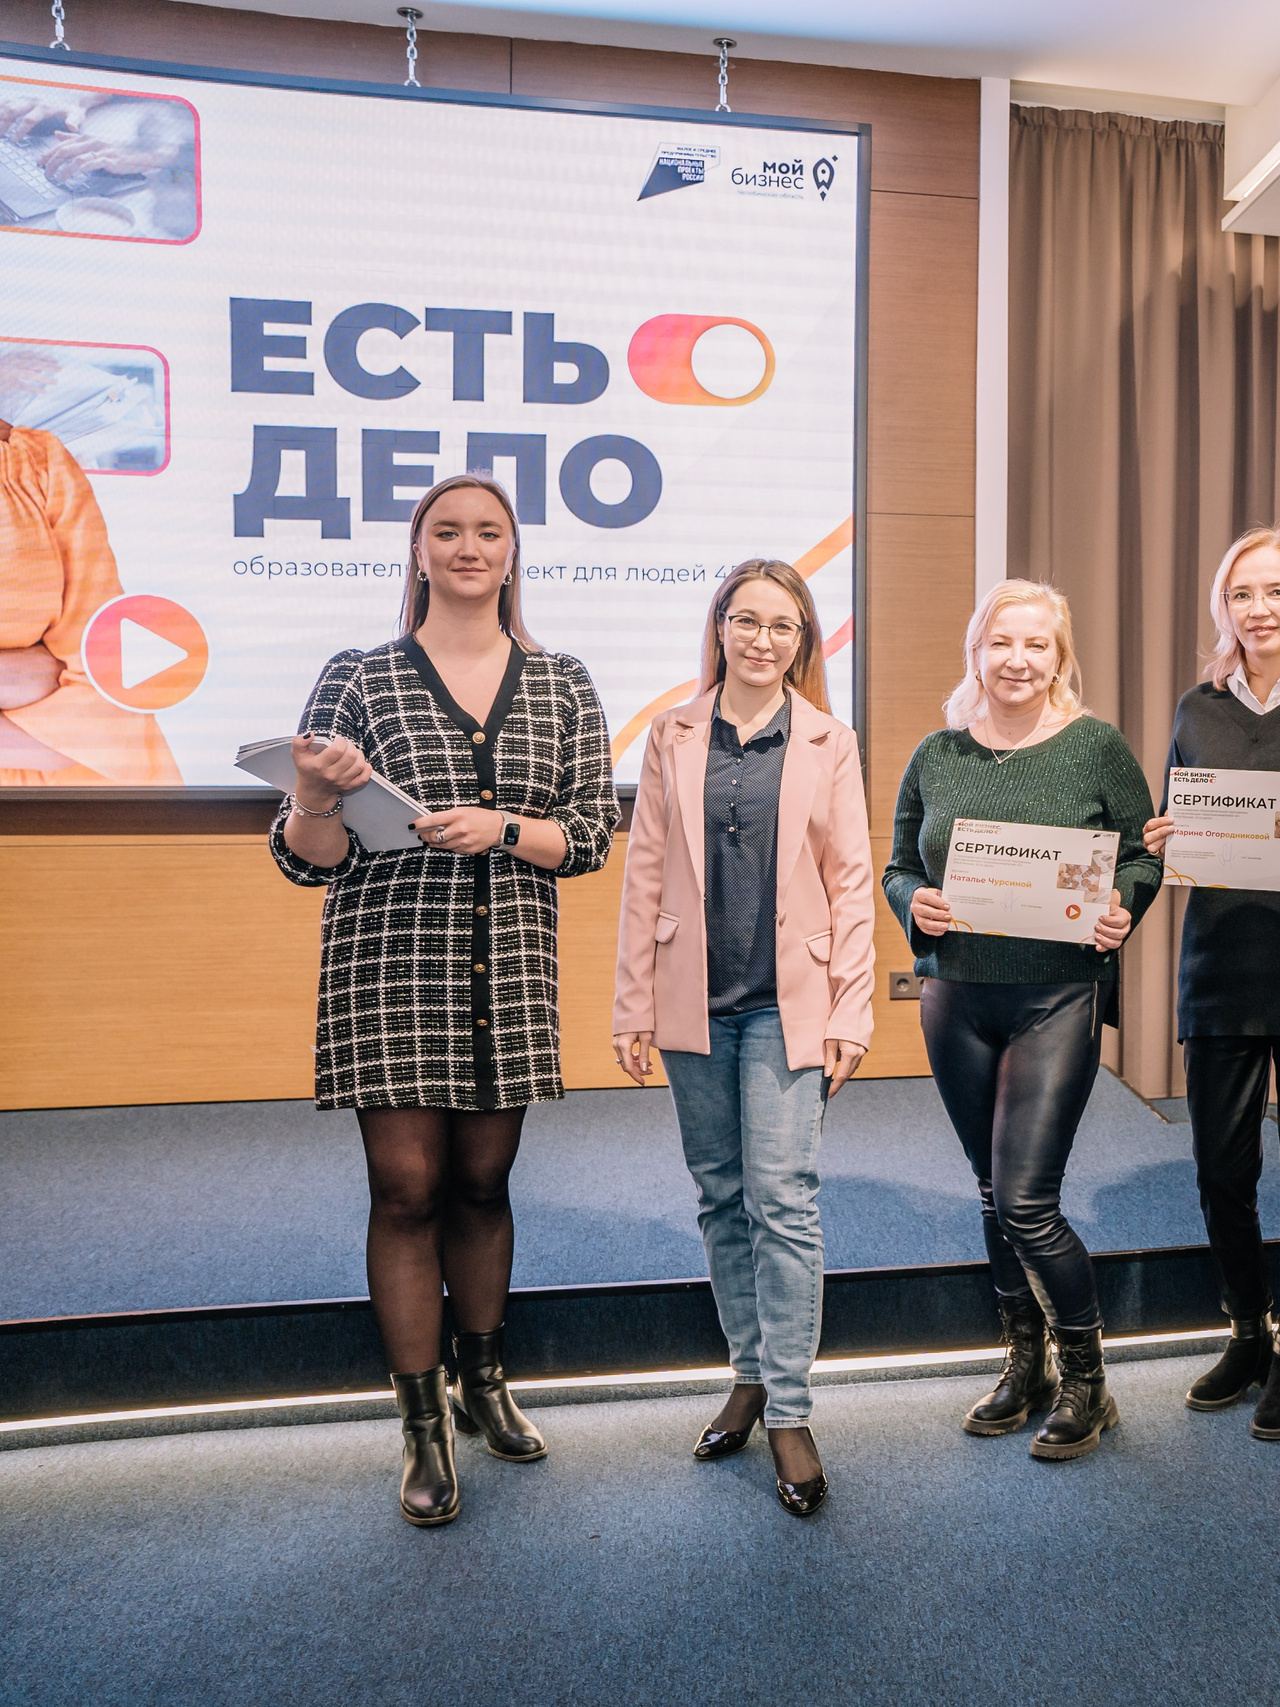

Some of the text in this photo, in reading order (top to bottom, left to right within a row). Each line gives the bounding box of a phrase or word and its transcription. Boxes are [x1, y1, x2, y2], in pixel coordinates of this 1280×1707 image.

[678, 166, 704, 174] ПРОЕКТЫ
[732, 168, 804, 189] бизнес
[229, 297, 610, 405] ЕСТЬ
[233, 424, 663, 540] ДЕЛО
[233, 555, 408, 580] образовател
[573, 566, 617, 583] для
[625, 564, 706, 584] людей
[1173, 793, 1277, 810] СЕРТИФИКАТ
[1173, 829, 1270, 840] Марине Огородниковой
[954, 841, 1062, 861] СЕРТИФИКАТ
[950, 873, 1032, 888] Наталье Чурсиной
